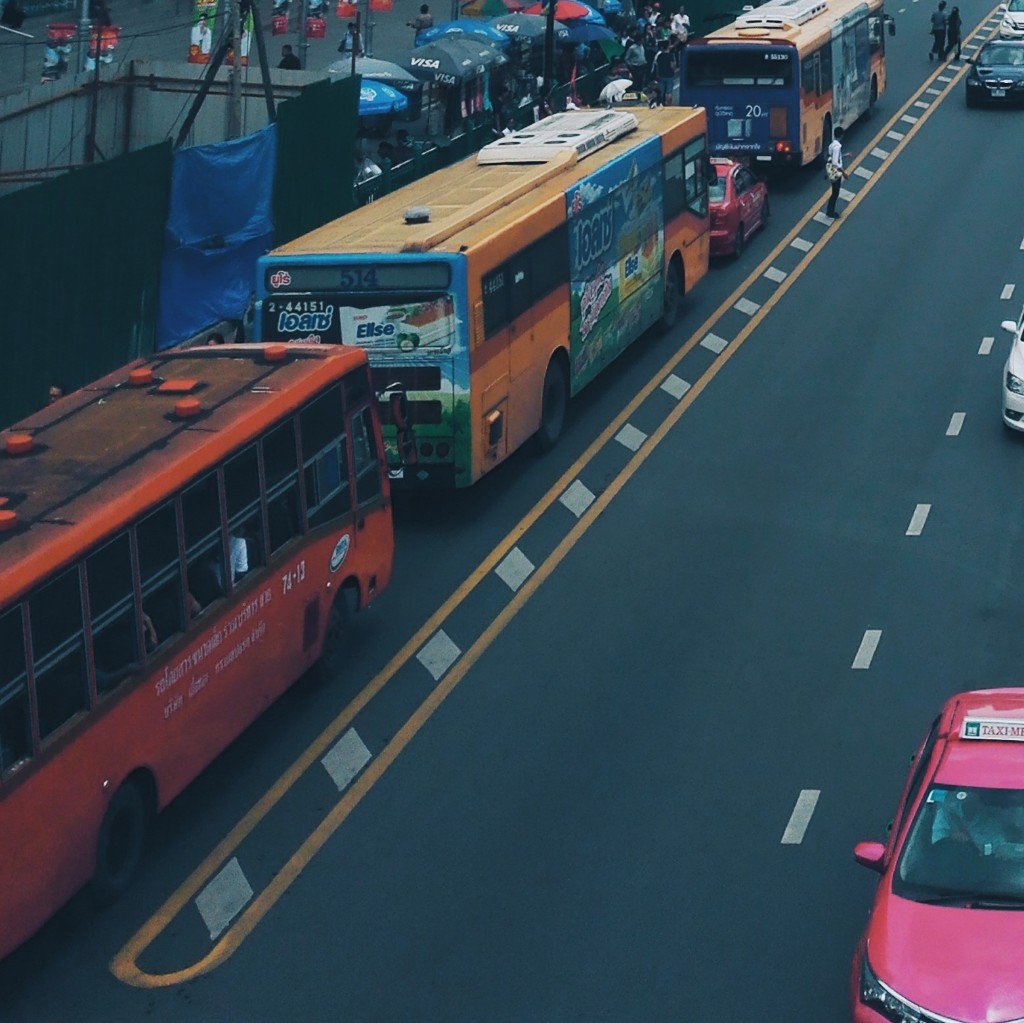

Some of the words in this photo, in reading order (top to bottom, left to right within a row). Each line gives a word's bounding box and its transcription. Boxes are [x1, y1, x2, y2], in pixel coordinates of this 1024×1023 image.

[496, 24, 519, 33] VISA
[411, 57, 440, 69] VISA
[434, 73, 456, 85] VISA
[746, 105, 761, 117] 20
[271, 271, 291, 288] ยูโร่
[340, 269, 380, 289] 514
